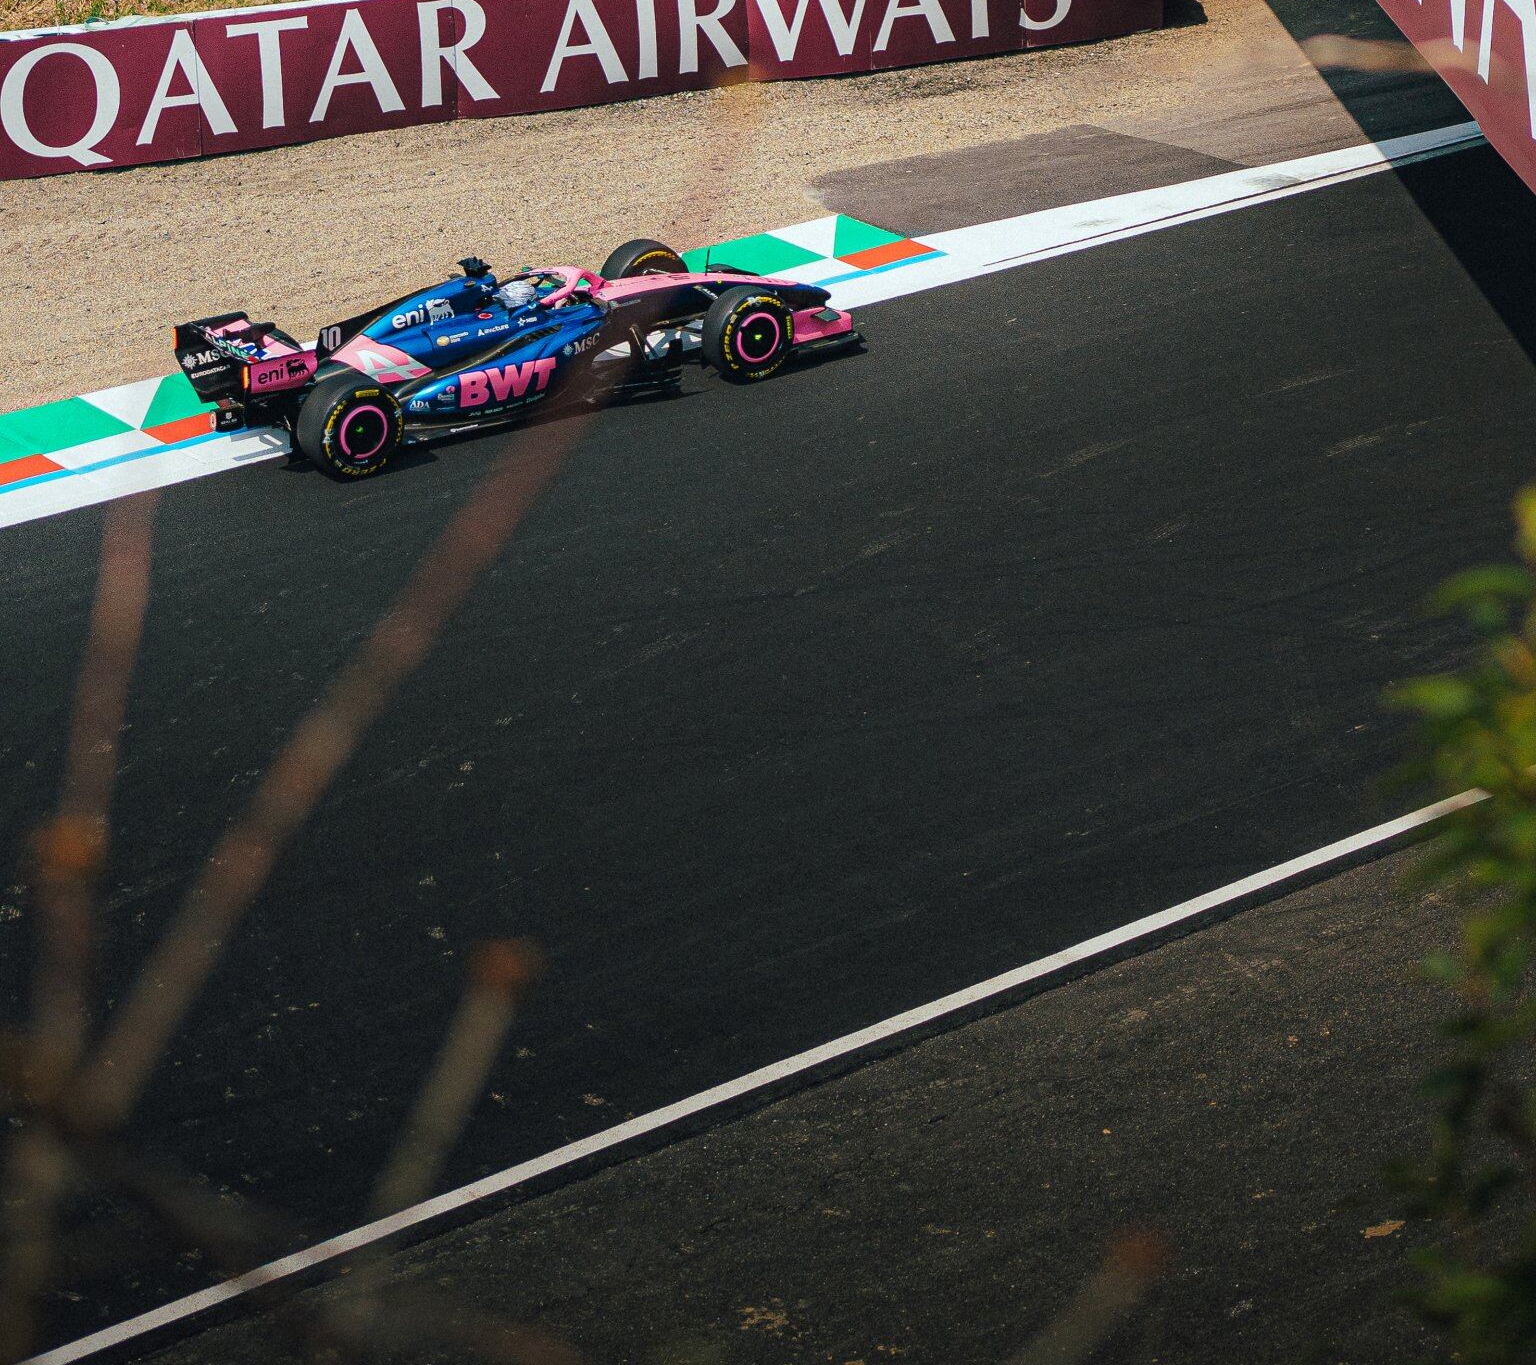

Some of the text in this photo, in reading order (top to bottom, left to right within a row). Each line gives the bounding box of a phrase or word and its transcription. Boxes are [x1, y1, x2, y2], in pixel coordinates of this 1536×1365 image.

[0, 2, 500, 167] QATAR
[392, 304, 425, 329] eni
[321, 326, 342, 352] 10
[573, 333, 600, 355] MSC
[258, 363, 284, 385] eni
[458, 357, 557, 408] BWT
[410, 399, 430, 409] ADA
